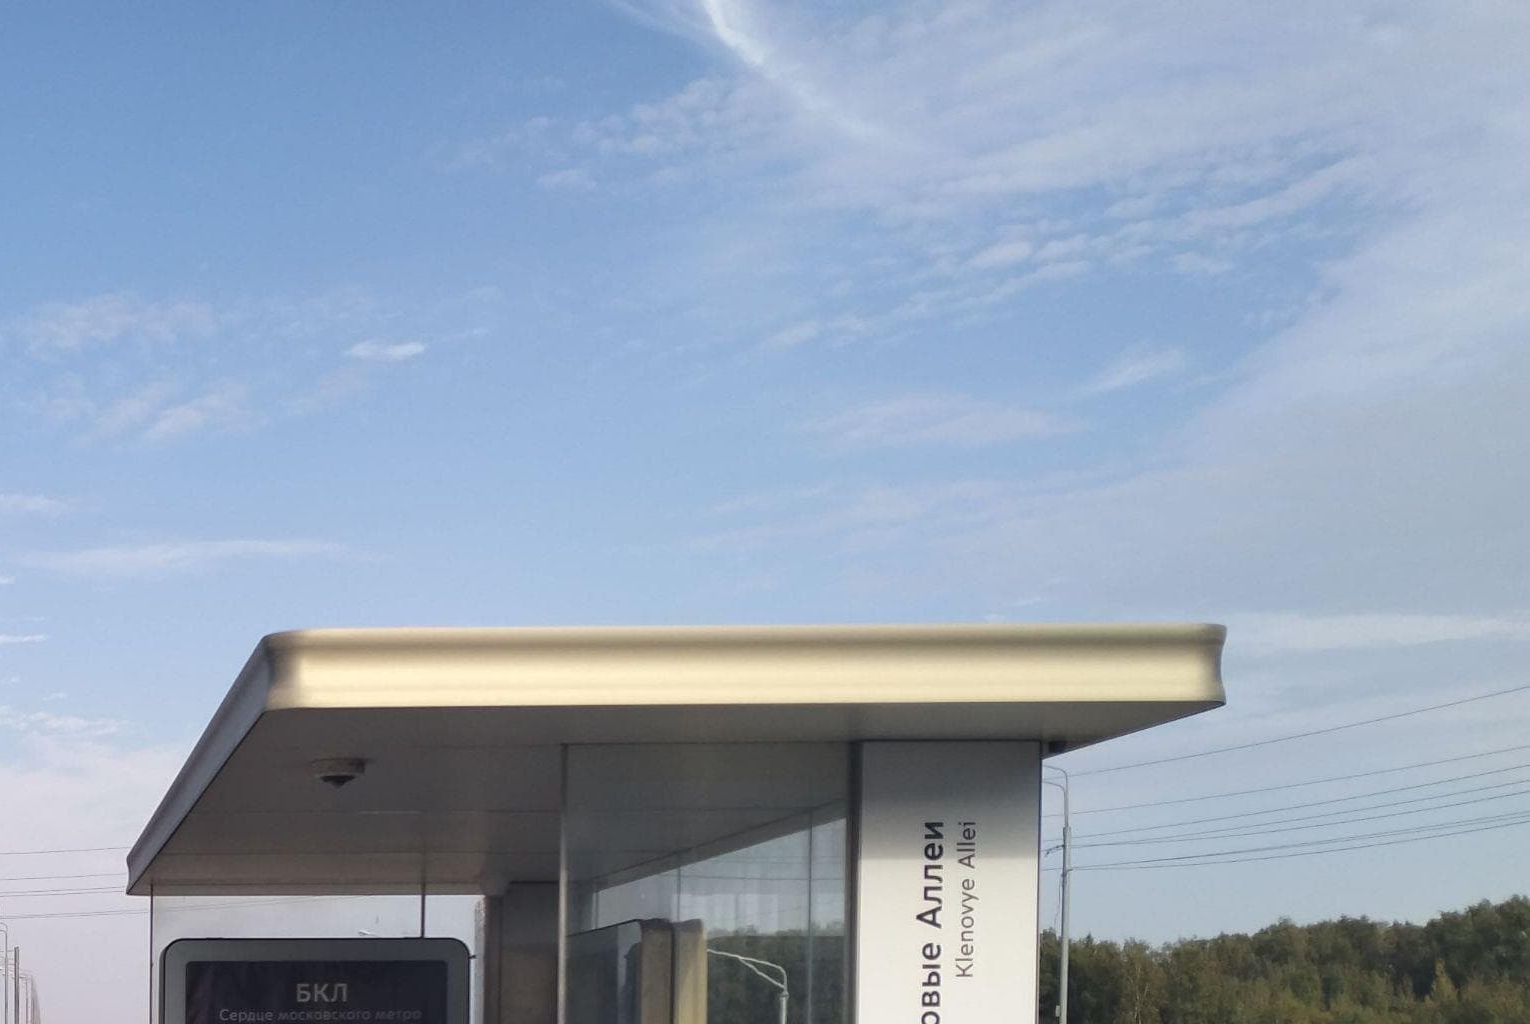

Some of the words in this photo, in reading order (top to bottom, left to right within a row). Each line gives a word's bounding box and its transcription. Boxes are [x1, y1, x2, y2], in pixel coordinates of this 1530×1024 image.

[956, 821, 977, 869] Allei
[916, 821, 944, 930] Аллеи
[955, 878, 979, 977] Klenovye
[219, 1008, 273, 1023] Сердце
[277, 1009, 371, 1022] московского
[375, 1009, 422, 1022] метро
[295, 982, 349, 1003] БКЛ
